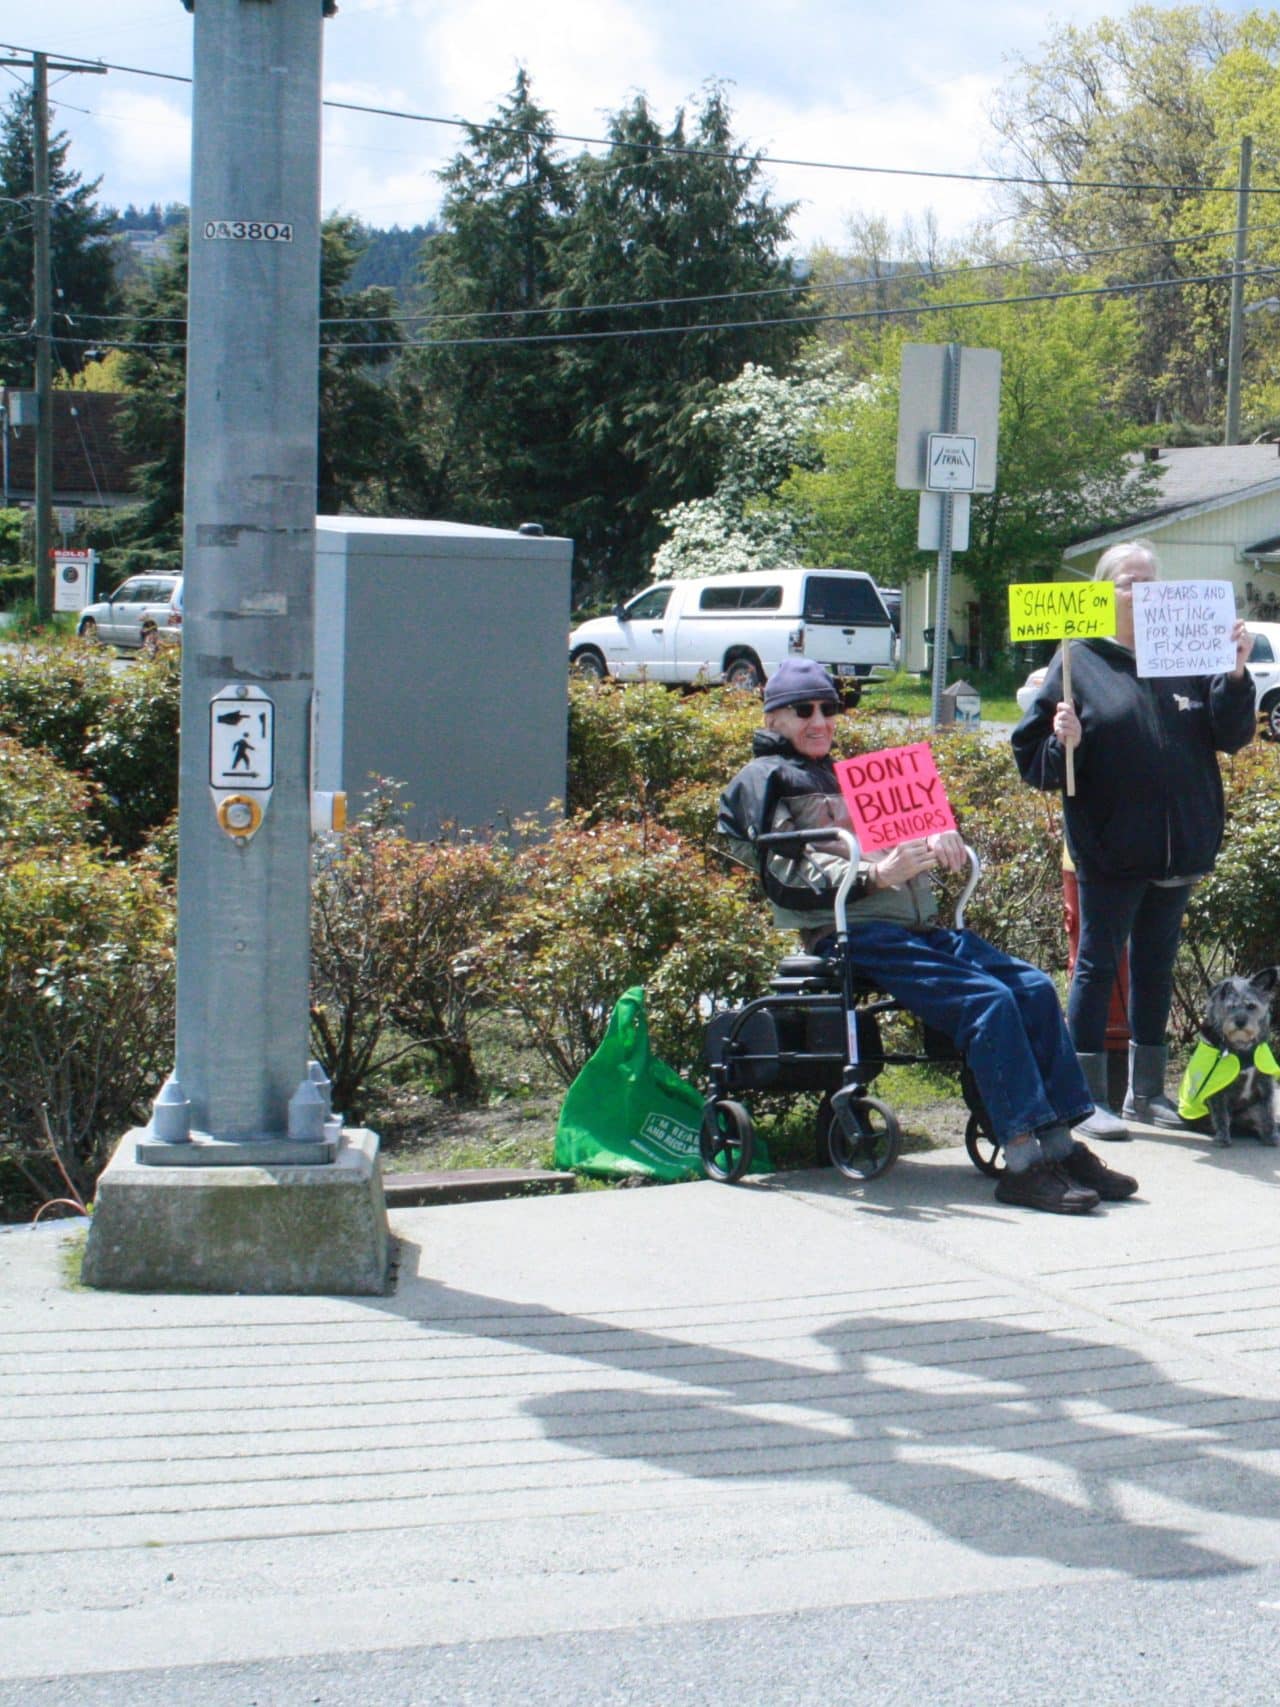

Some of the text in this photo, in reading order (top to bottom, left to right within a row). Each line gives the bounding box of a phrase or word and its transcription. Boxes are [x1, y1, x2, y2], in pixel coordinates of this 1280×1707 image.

[1093, 596, 1109, 608] ON
[1142, 584, 1226, 604] 2 YEARS AND
[1144, 602, 1216, 623] WAITING
[1146, 623, 1226, 642] FOR NAHS TO
[1154, 638, 1223, 657] FIX OUR
[846, 750, 919, 789] DON'T
[854, 778, 937, 824] BULLY
[868, 809, 947, 844] SENIORS
